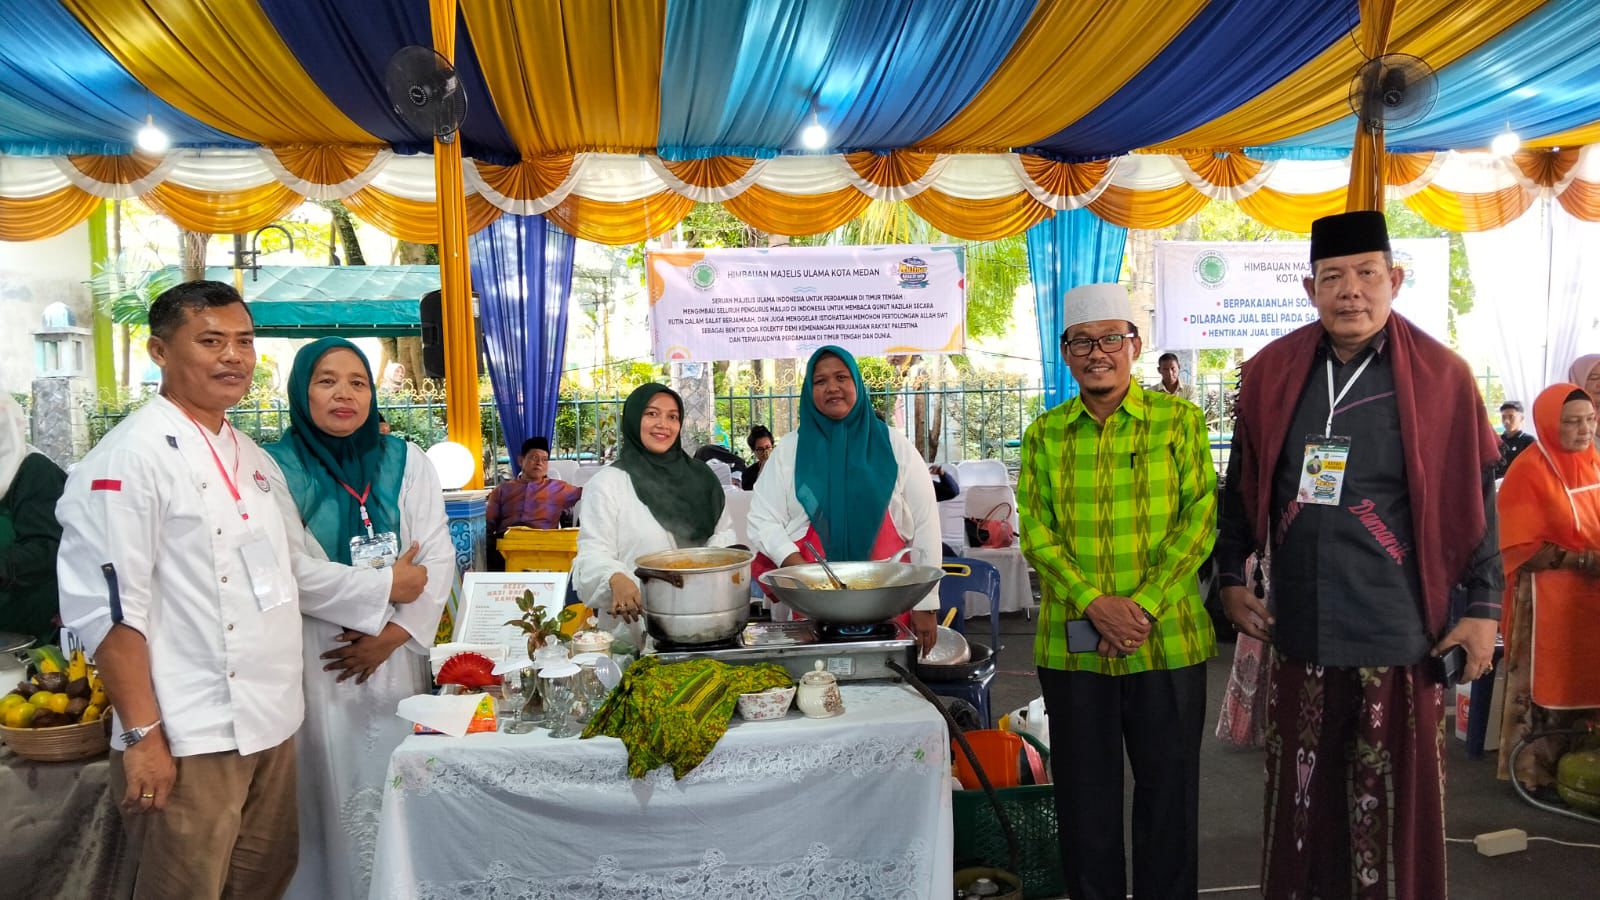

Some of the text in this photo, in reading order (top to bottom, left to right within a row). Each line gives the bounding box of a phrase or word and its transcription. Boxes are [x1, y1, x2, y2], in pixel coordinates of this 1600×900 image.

[1244, 262, 1312, 271] HIMBAUAN MAJ
[727, 268, 880, 278] HIMBAUAN MAJELIS ULAMA KOTA MEDAN
[1276, 273, 1299, 283] KOTA
[1223, 298, 1293, 308] BERPAKAIANLAH
[1190, 313, 1317, 324] DILARANG JUAL BELI PADA SA
[1209, 328, 1248, 337] HENTIKAN
[1250, 328, 1269, 336] JUAL
